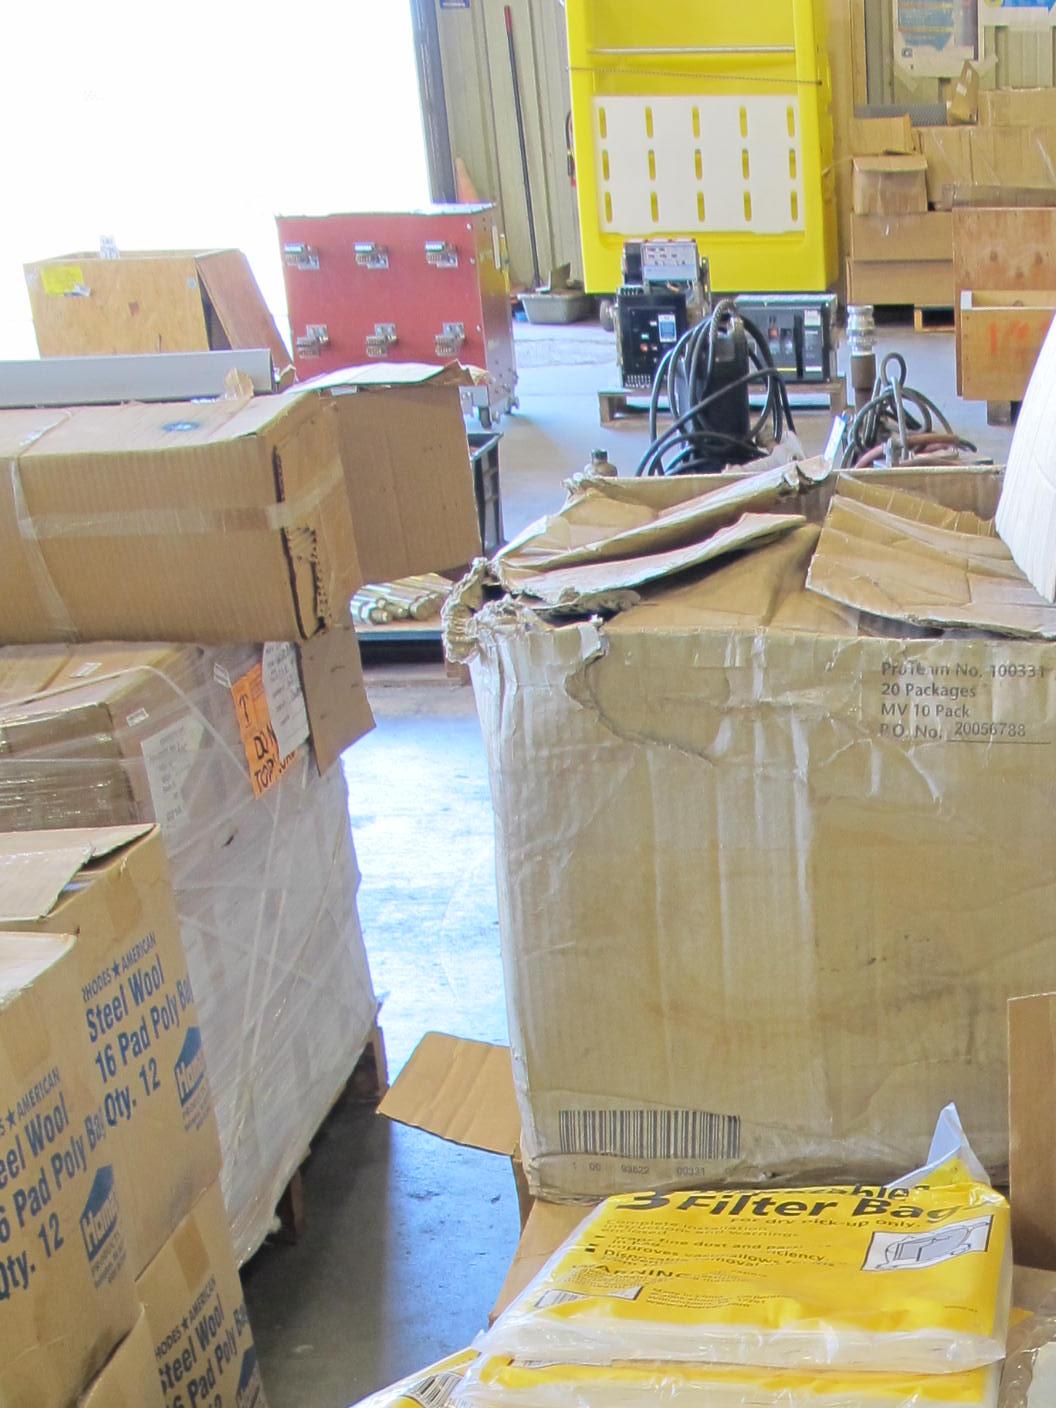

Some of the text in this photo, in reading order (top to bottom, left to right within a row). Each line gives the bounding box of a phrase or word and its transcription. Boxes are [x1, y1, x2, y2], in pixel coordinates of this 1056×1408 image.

[881, 683, 977, 701] 20 Packages
[955, 663, 1045, 679] No. 100331
[881, 703, 970, 718] MV 10 Pack
[914, 725, 943, 740] No.
[954, 722, 1026, 738] 20056788
[121, 931, 157, 973] AMERICAN
[85, 953, 165, 1044] Steel Wool
[95, 993, 180, 1084] 16 Pad Poly
[15, 1066, 61, 1119] AMERICAN
[104, 1056, 161, 1128] Qty. 12
[23, 1091, 70, 1158] Wool
[13, 1134, 88, 1229] Pad Poly
[615, 1191, 671, 1211] 3
[676, 1192, 839, 1219] Filter
[38, 1211, 65, 1259] 12
[194, 1292, 226, 1353] Wool
[214, 1326, 238, 1376] Poly
